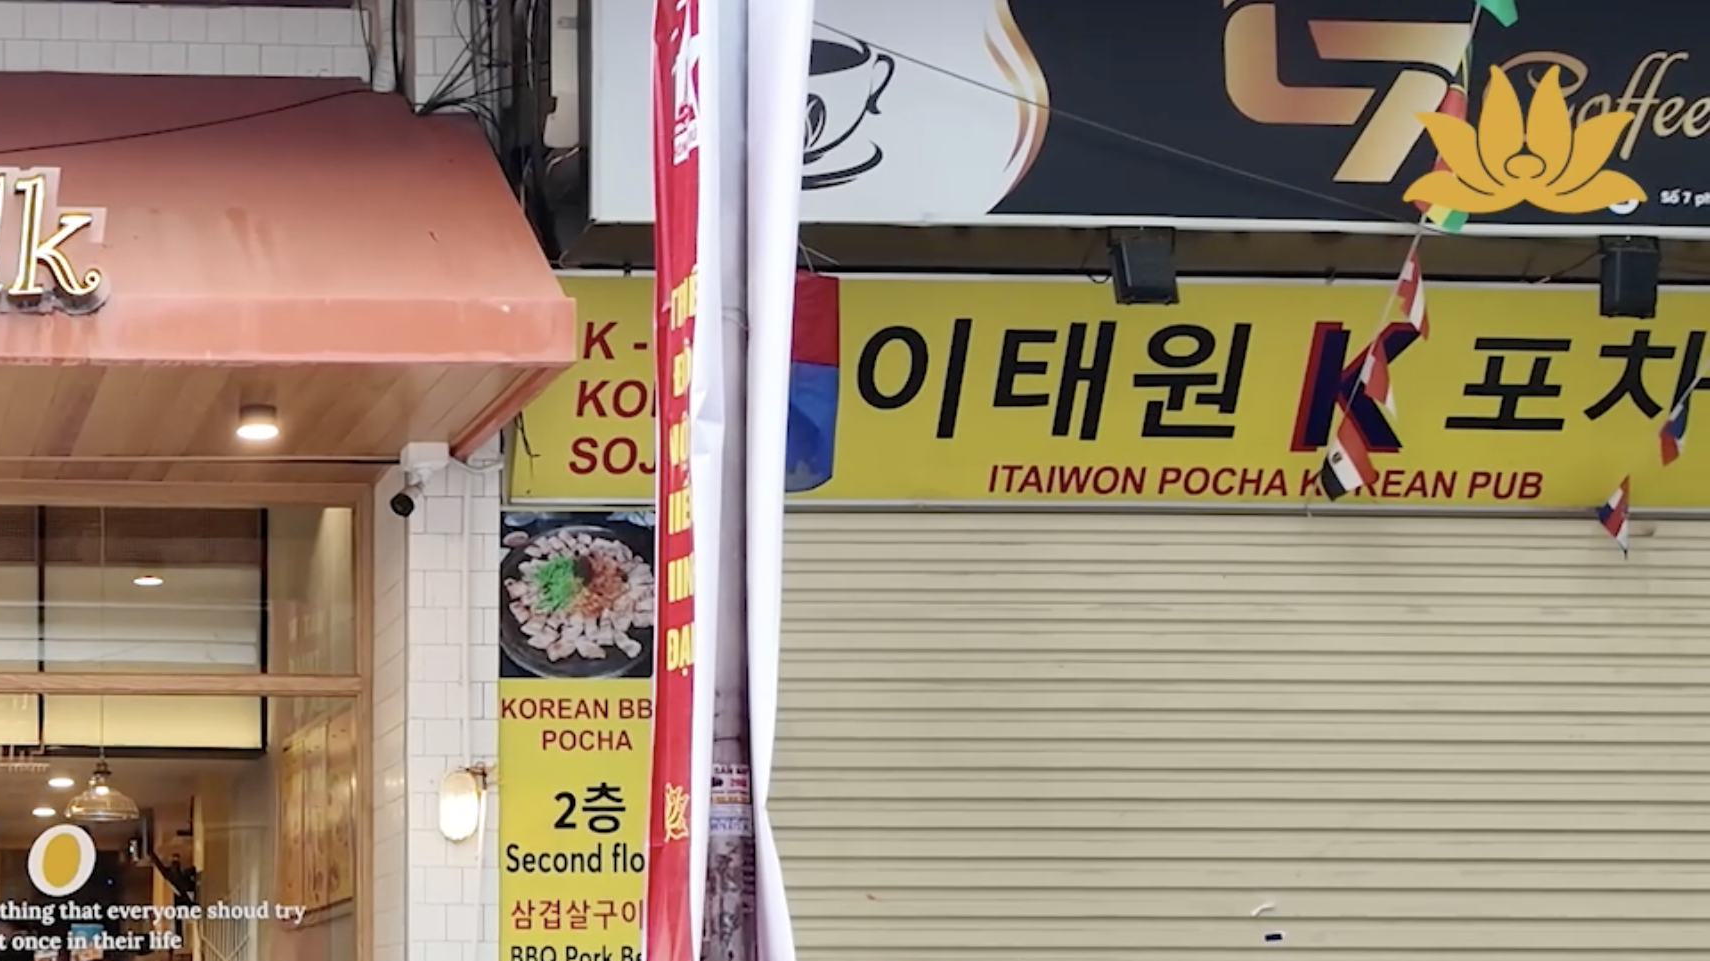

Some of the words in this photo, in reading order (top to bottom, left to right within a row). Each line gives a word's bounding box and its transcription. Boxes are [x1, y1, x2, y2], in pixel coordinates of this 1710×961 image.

[583, 321, 618, 360] K
[576, 380, 656, 418] KO
[856, 318, 1252, 440] 이태원
[1290, 322, 1421, 452] K
[988, 465, 1146, 495] ITAIWON
[1157, 467, 1288, 496] POCHA
[1300, 469, 1456, 498] KREAN
[1468, 470, 1543, 499] PUB
[501, 698, 609, 719] KOREAN
[542, 730, 633, 750] POCHA
[554, 782, 626, 834] 2층
[506, 843, 602, 873] Second
[59, 900, 102, 920] that
[106, 904, 202, 926] everyone
[207, 900, 270, 920] shoud
[275, 903, 307, 925] try
[511, 900, 643, 930] 삼겹살구이
[11, 935, 62, 950] once
[67, 931, 87, 950] in
[93, 931, 145, 950] their
[149, 930, 183, 950] life
